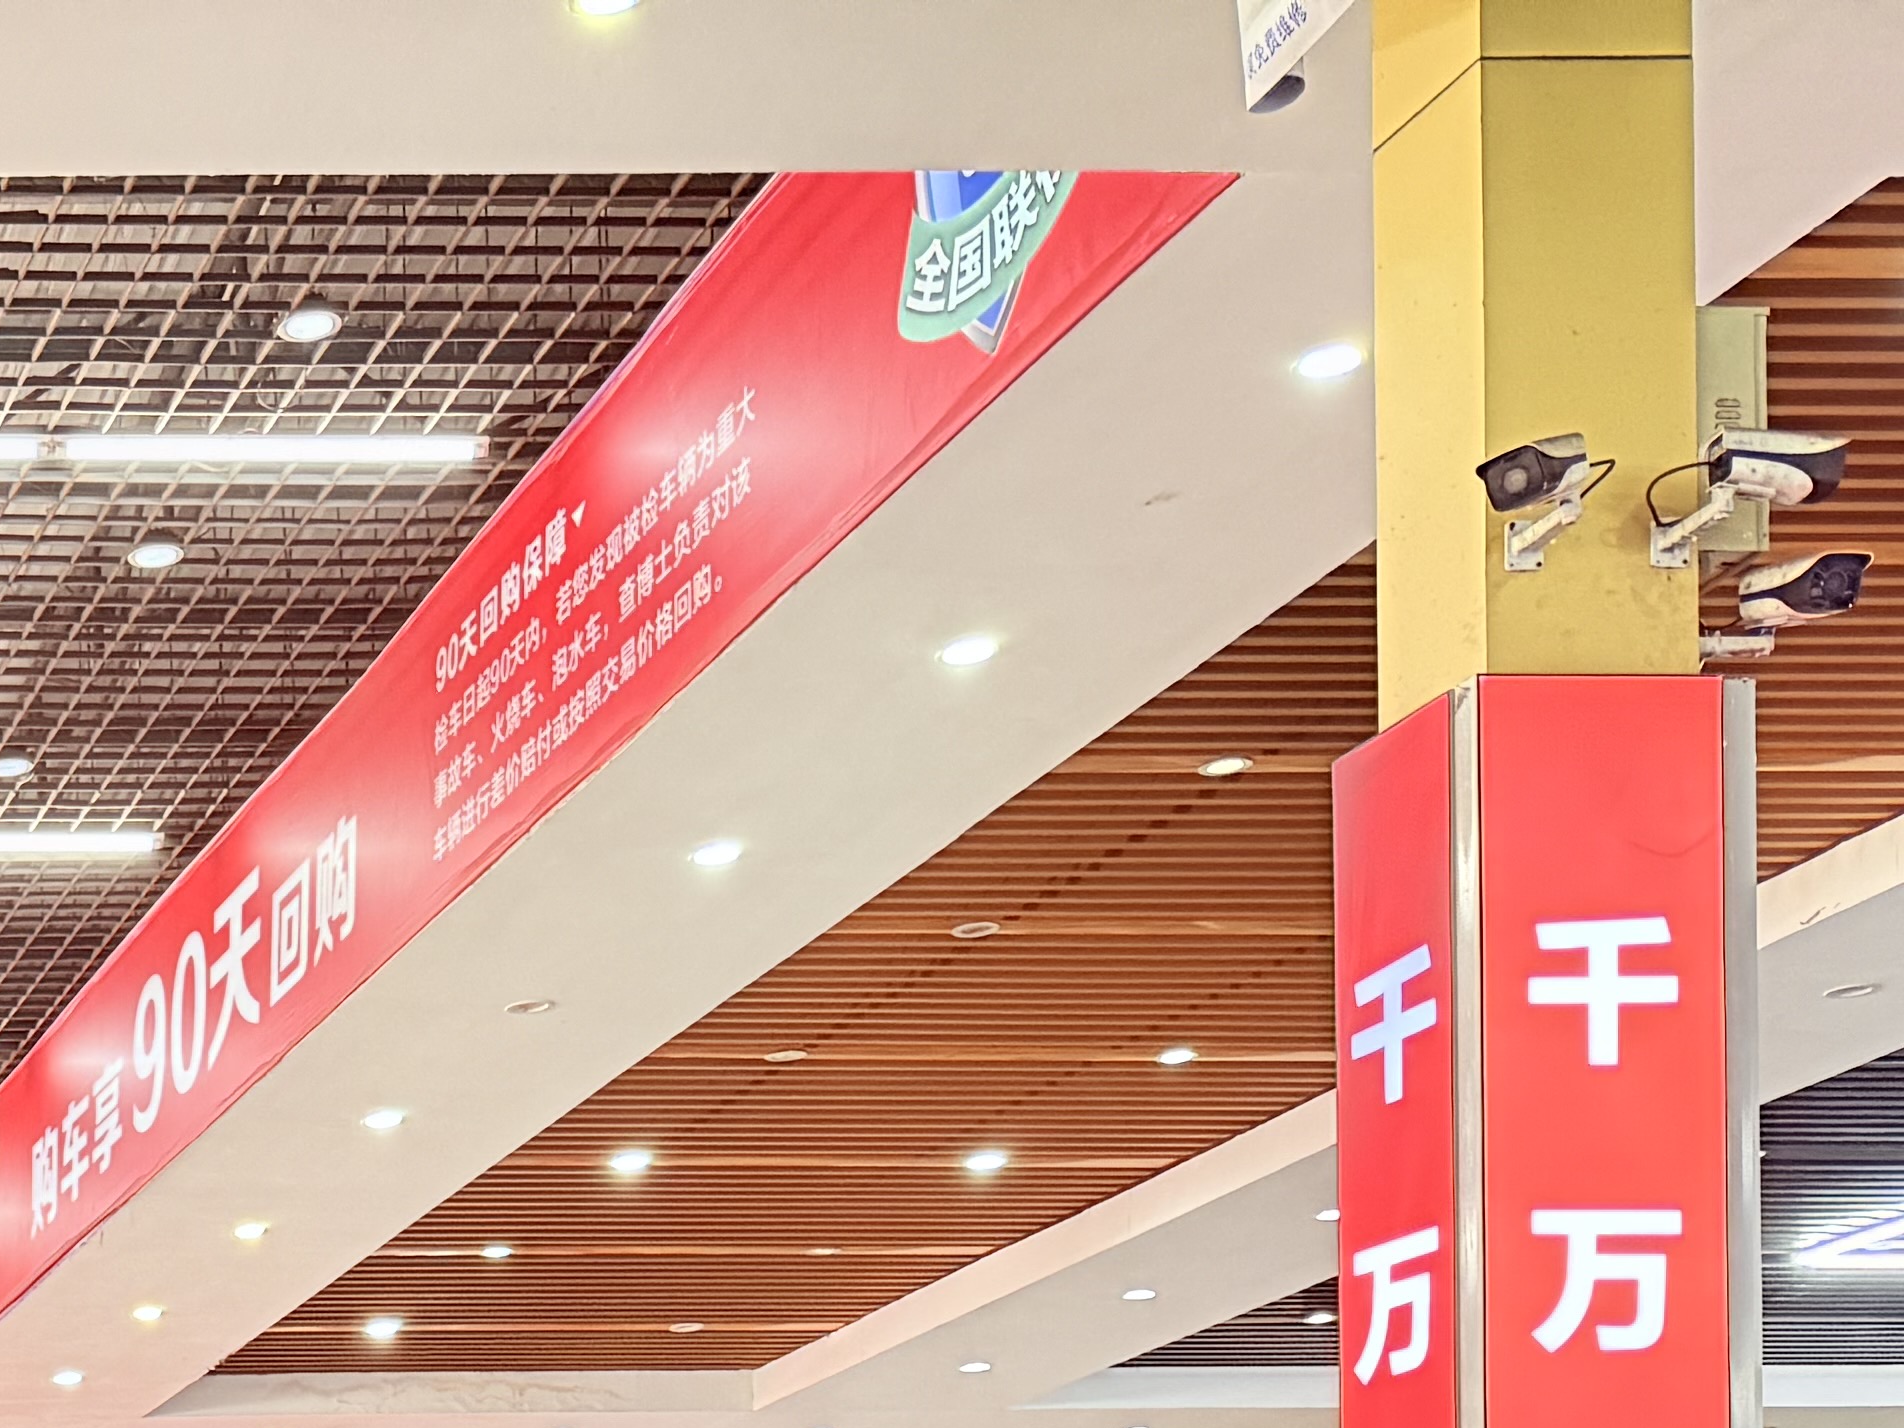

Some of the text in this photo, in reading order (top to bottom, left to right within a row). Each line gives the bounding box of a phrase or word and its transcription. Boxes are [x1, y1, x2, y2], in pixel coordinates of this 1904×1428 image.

[434, 507, 569, 694] 90天回购保障
[30, 815, 358, 1240] 购车享90天回购
